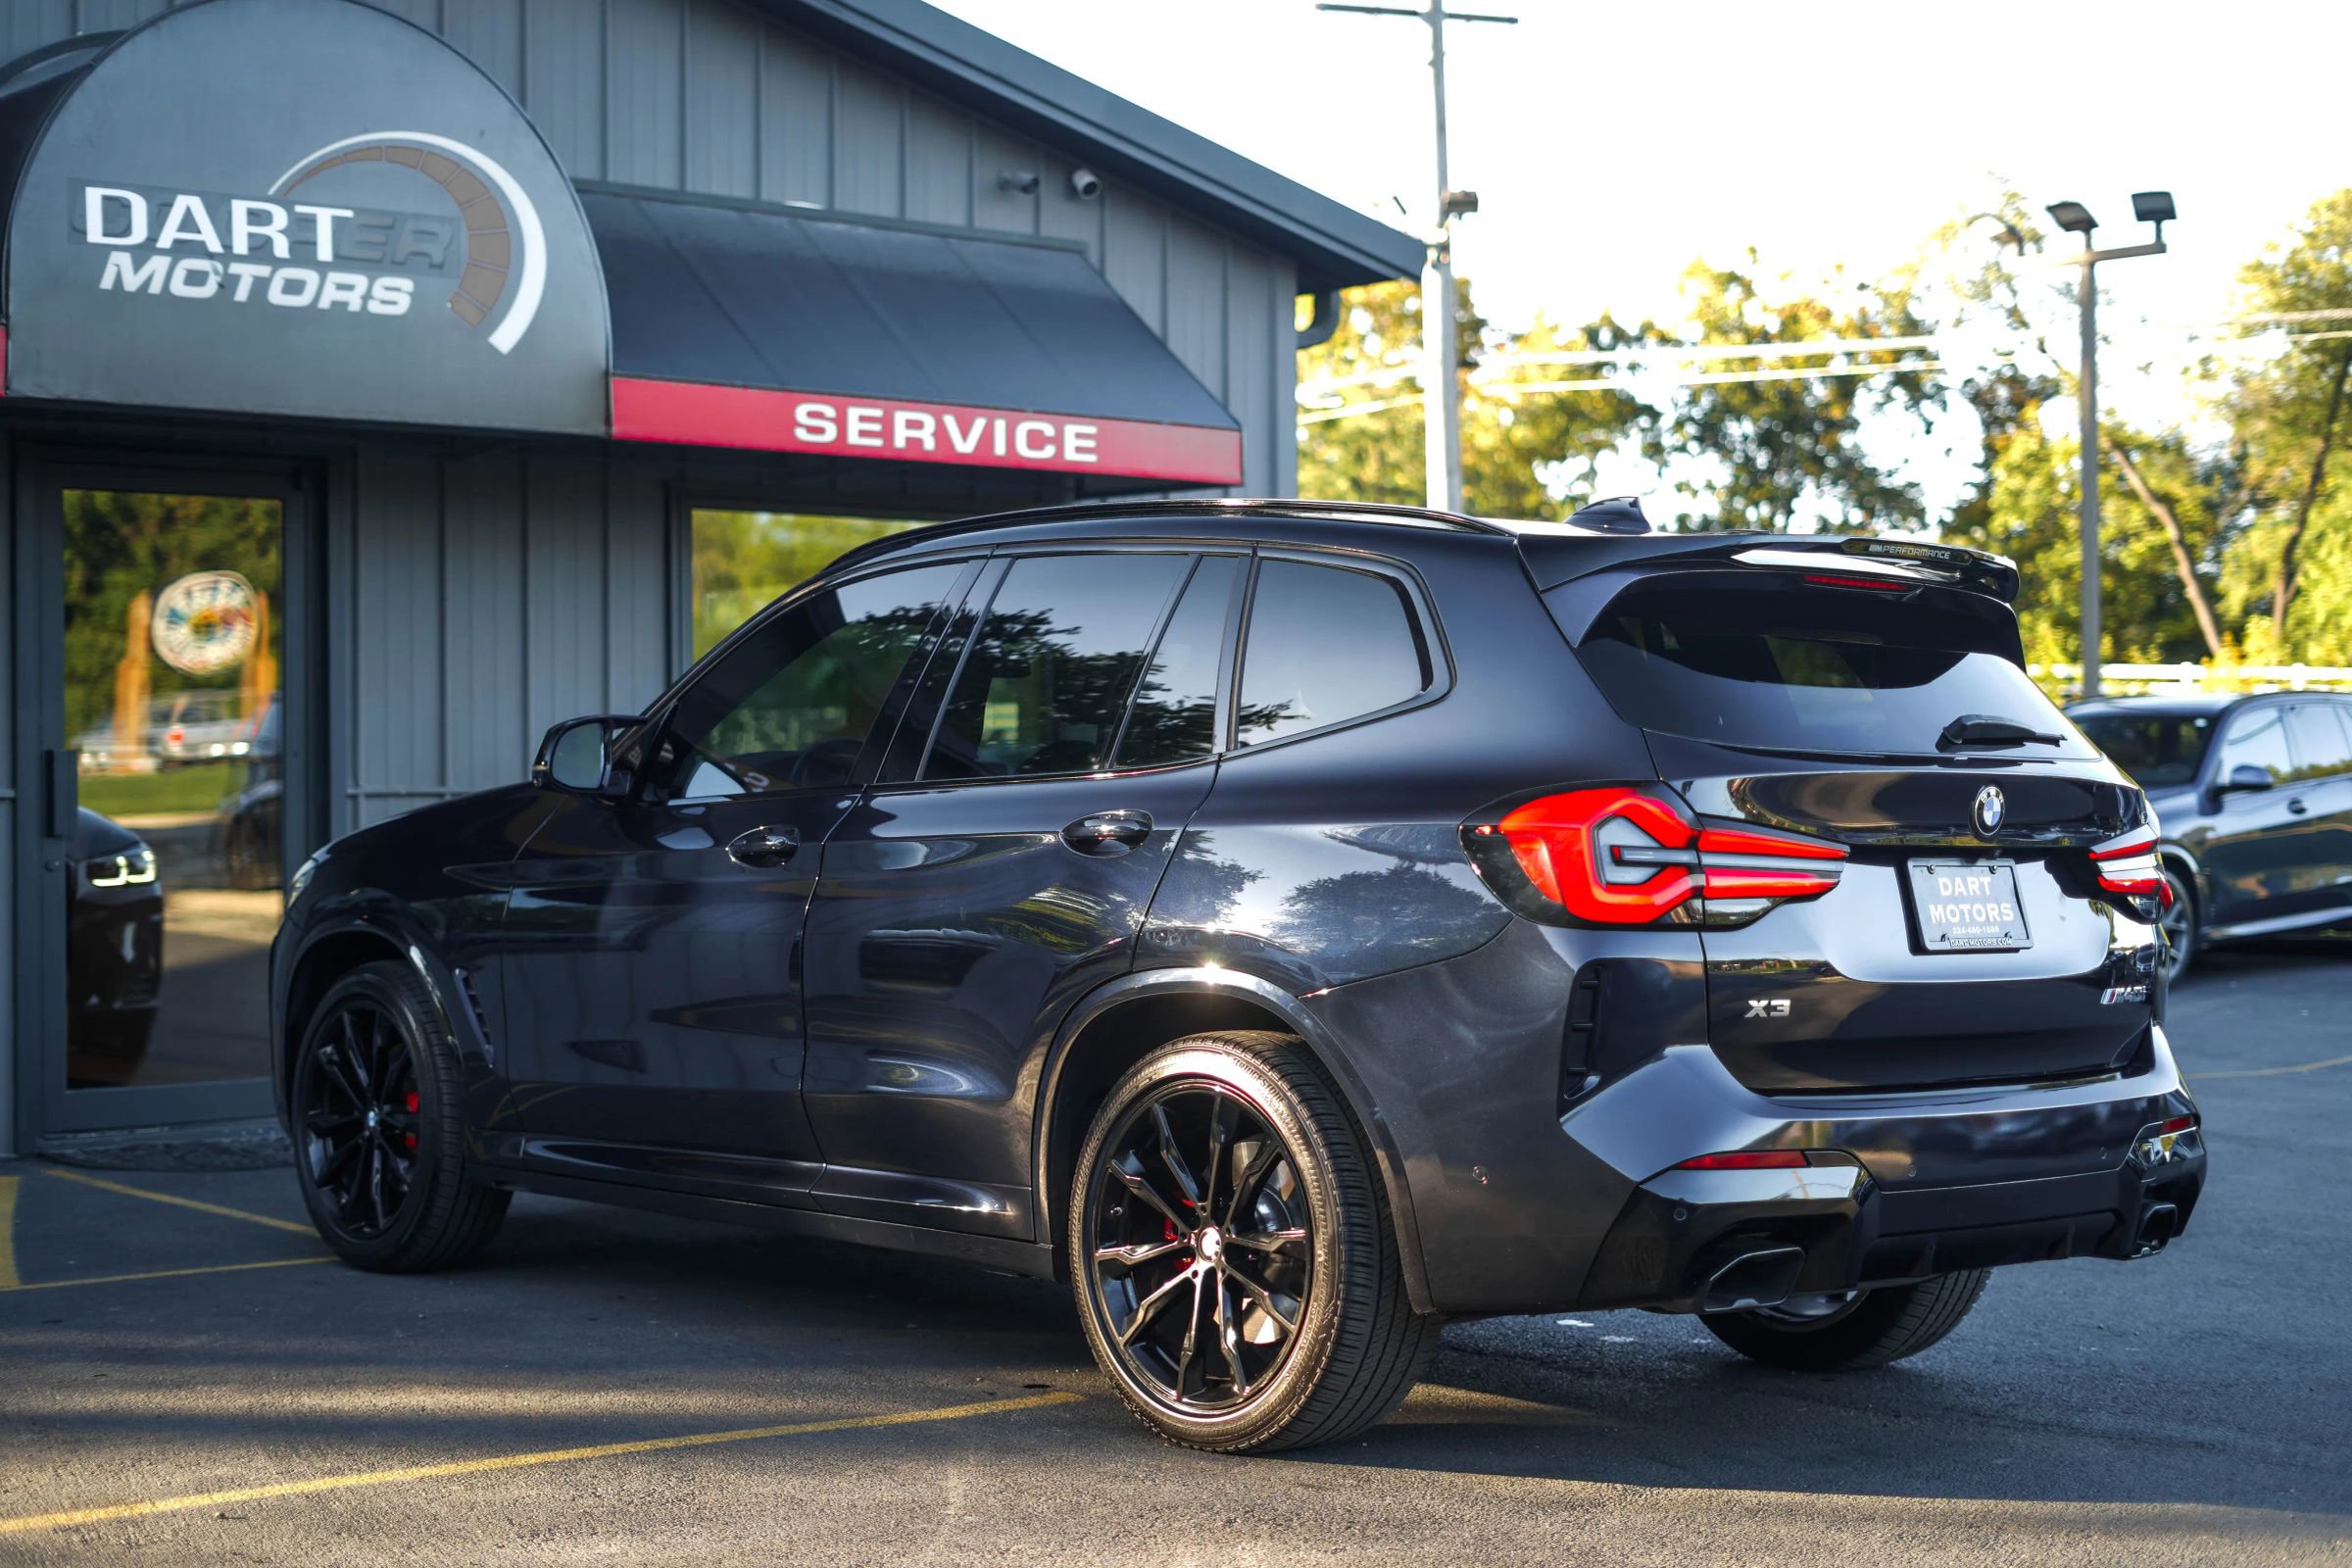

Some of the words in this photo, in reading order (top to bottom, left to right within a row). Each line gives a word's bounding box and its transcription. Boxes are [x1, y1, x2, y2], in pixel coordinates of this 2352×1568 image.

[84, 186, 354, 263] DART
[99, 250, 415, 316] MOTORS
[794, 402, 1099, 463] SERVICE
[1883, 545, 1951, 560] PERFORMANCE
[1937, 876, 1991, 897] DART
[1929, 903, 2015, 924] MOTORS
[1744, 999, 1790, 1018] X3
